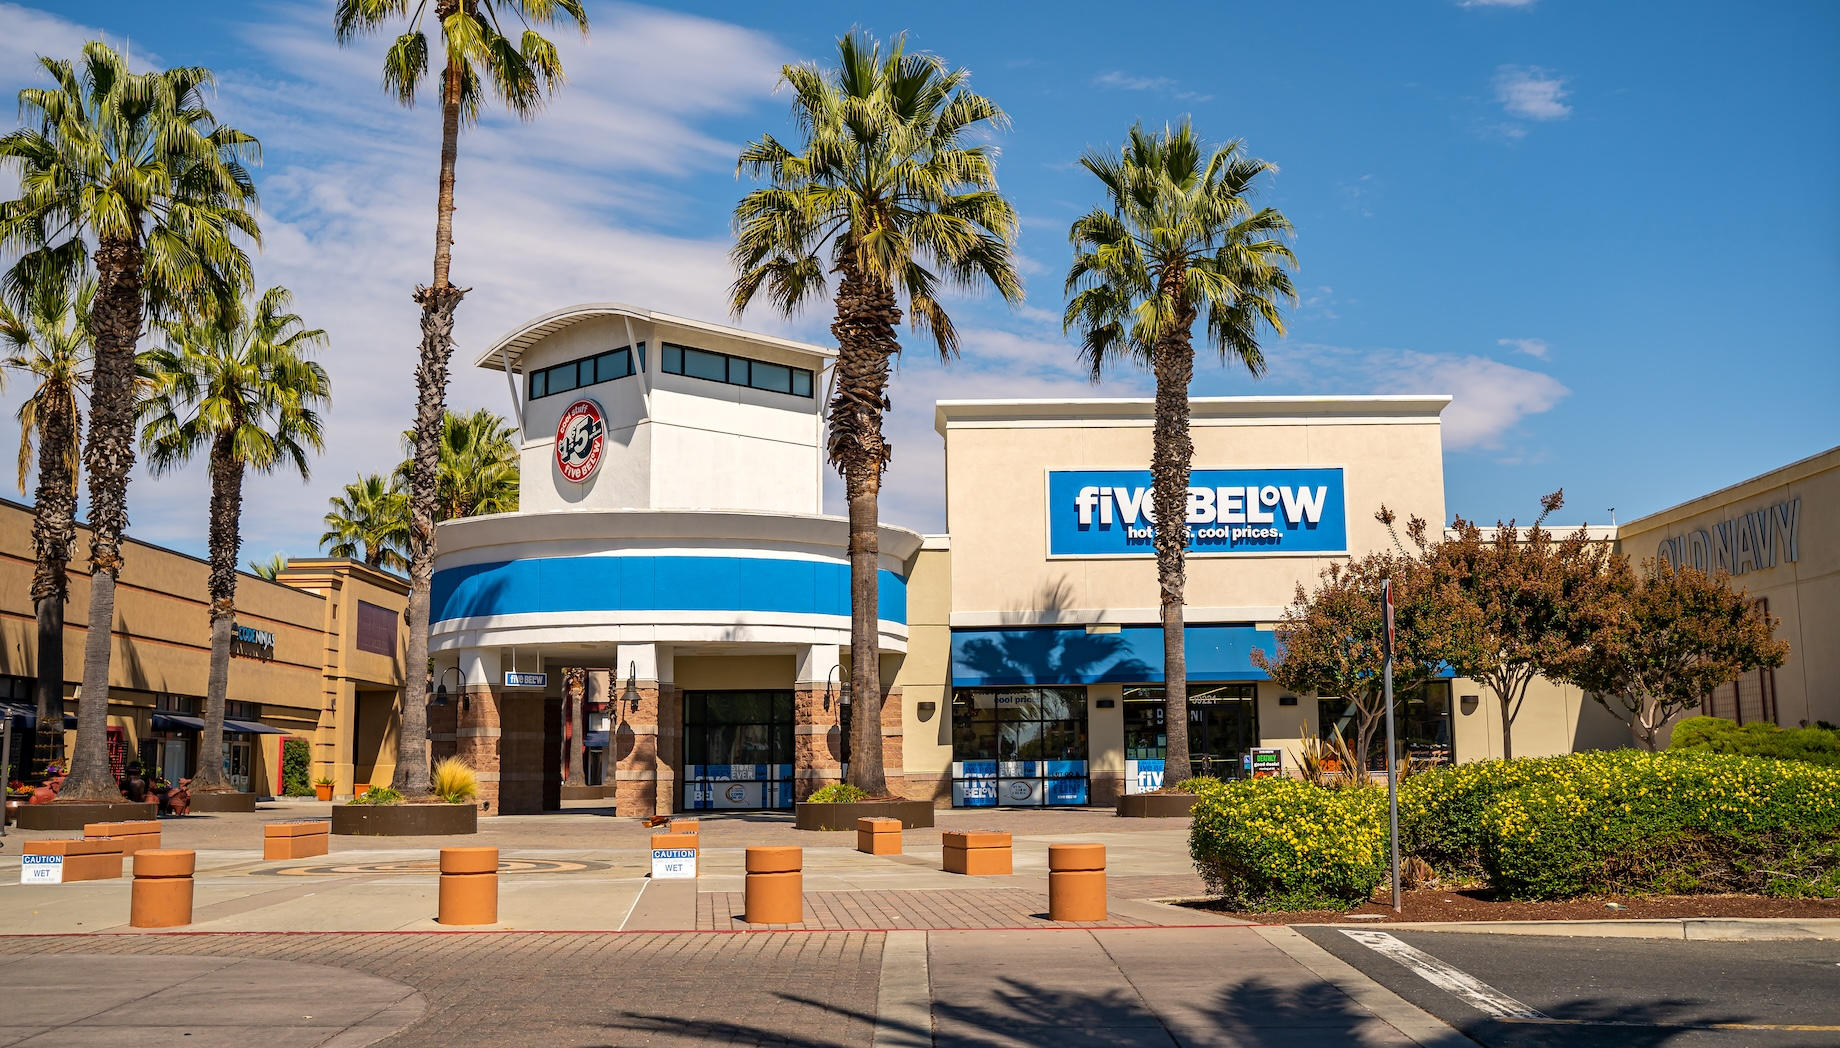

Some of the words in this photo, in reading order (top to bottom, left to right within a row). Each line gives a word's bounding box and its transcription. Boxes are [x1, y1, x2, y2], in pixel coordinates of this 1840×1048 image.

[564, 465, 581, 478] five
[581, 441, 601, 476] BELOW
[1186, 485, 1328, 523] BELOW
[1128, 526, 1153, 538] hot
[1198, 525, 1229, 538] cool
[1232, 525, 1284, 541] prices.
[1712, 500, 1800, 576] NAVY
[510, 675, 523, 684] five
[525, 676, 543, 684] BELOW
[994, 695, 1013, 703] cool
[1015, 695, 1031, 704] pric
[1138, 771, 1164, 787] fiv
[964, 787, 997, 798] BELOW
[654, 850, 694, 858] CAUTION
